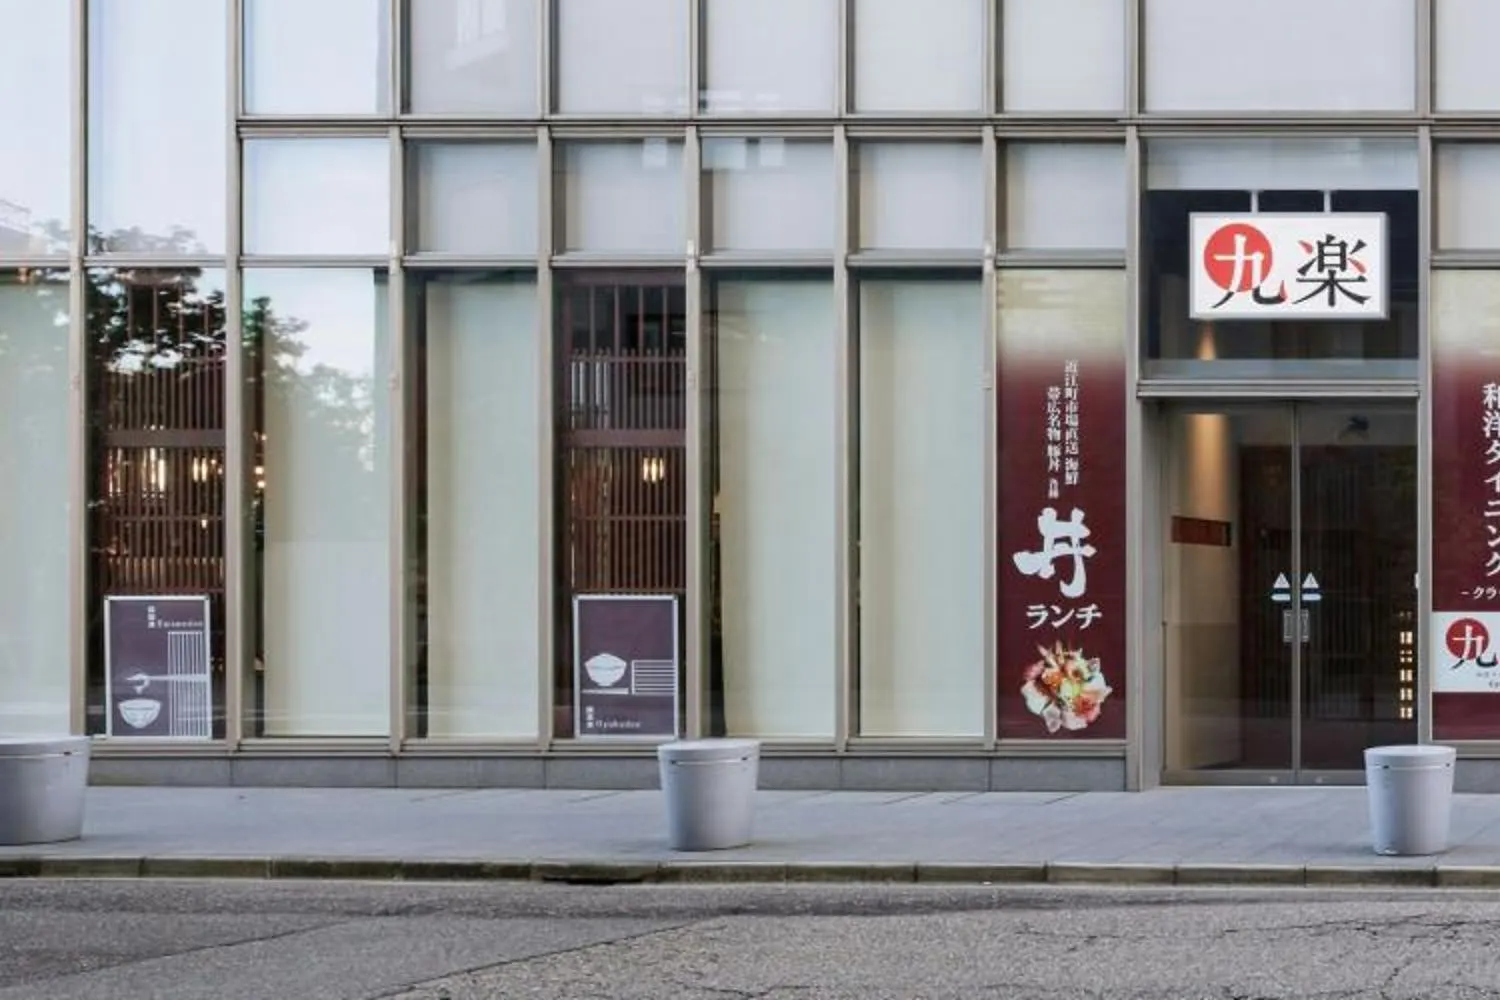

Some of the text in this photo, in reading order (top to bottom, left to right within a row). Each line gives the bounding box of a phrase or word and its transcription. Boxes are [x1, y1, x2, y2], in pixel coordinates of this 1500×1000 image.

[1211, 233, 1372, 309] 九楽
[1025, 603, 1103, 629] ランチ
